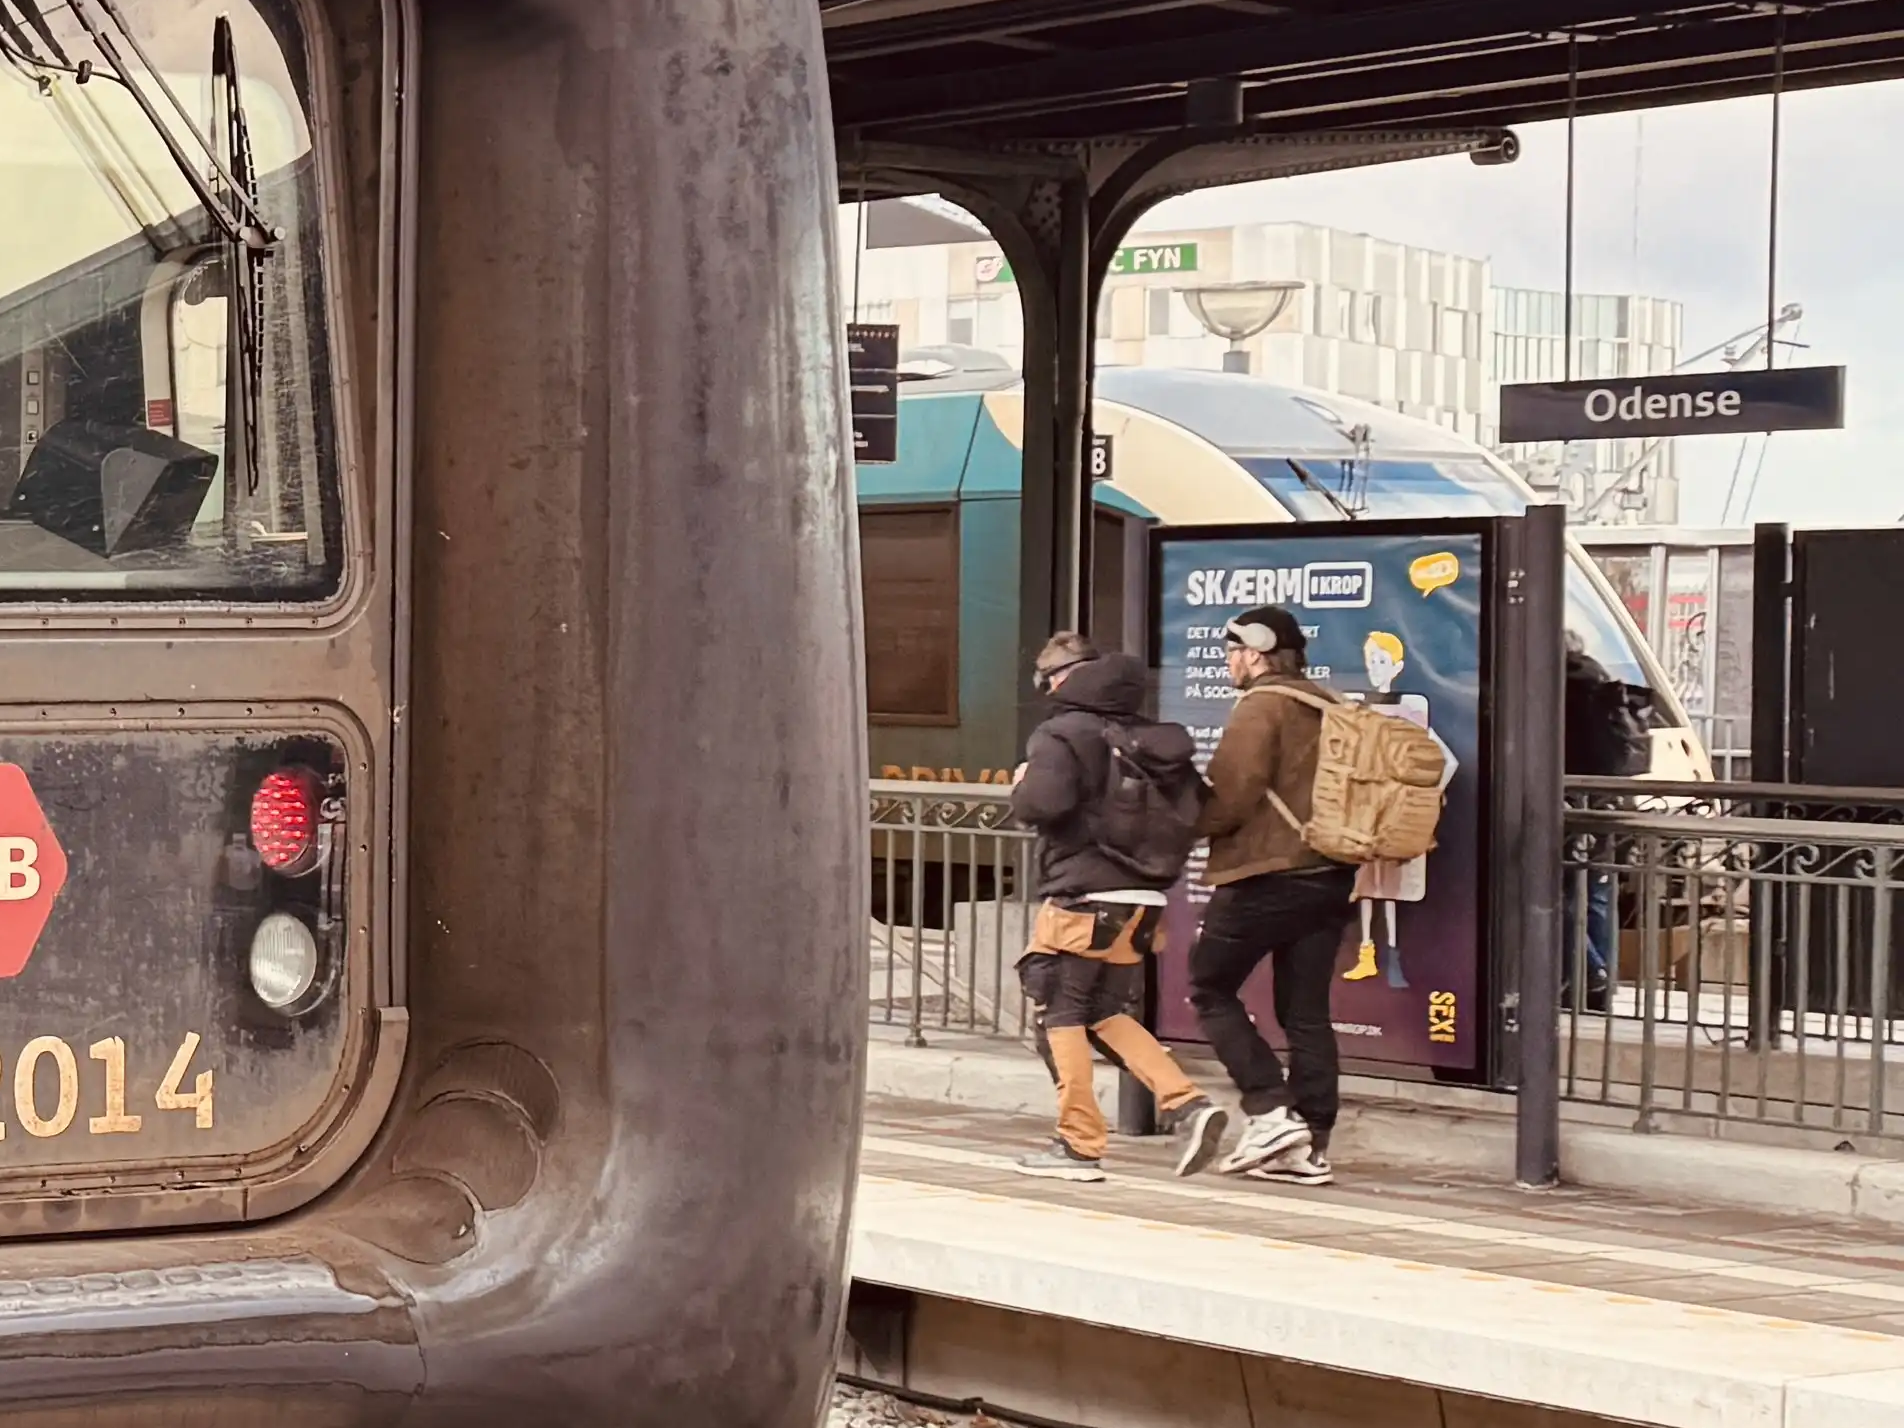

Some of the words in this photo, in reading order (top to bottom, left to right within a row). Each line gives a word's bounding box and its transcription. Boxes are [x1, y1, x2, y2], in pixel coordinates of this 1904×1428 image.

[1134, 247, 1181, 270] FYN
[1584, 385, 1741, 422] Odense
[1091, 447, 1106, 475] 8
[1186, 567, 1303, 606] SKÆRM
[1319, 574, 1363, 596] KROP
[1186, 626, 1210, 640] DET
[1185, 665, 1231, 679] SNÆVR
